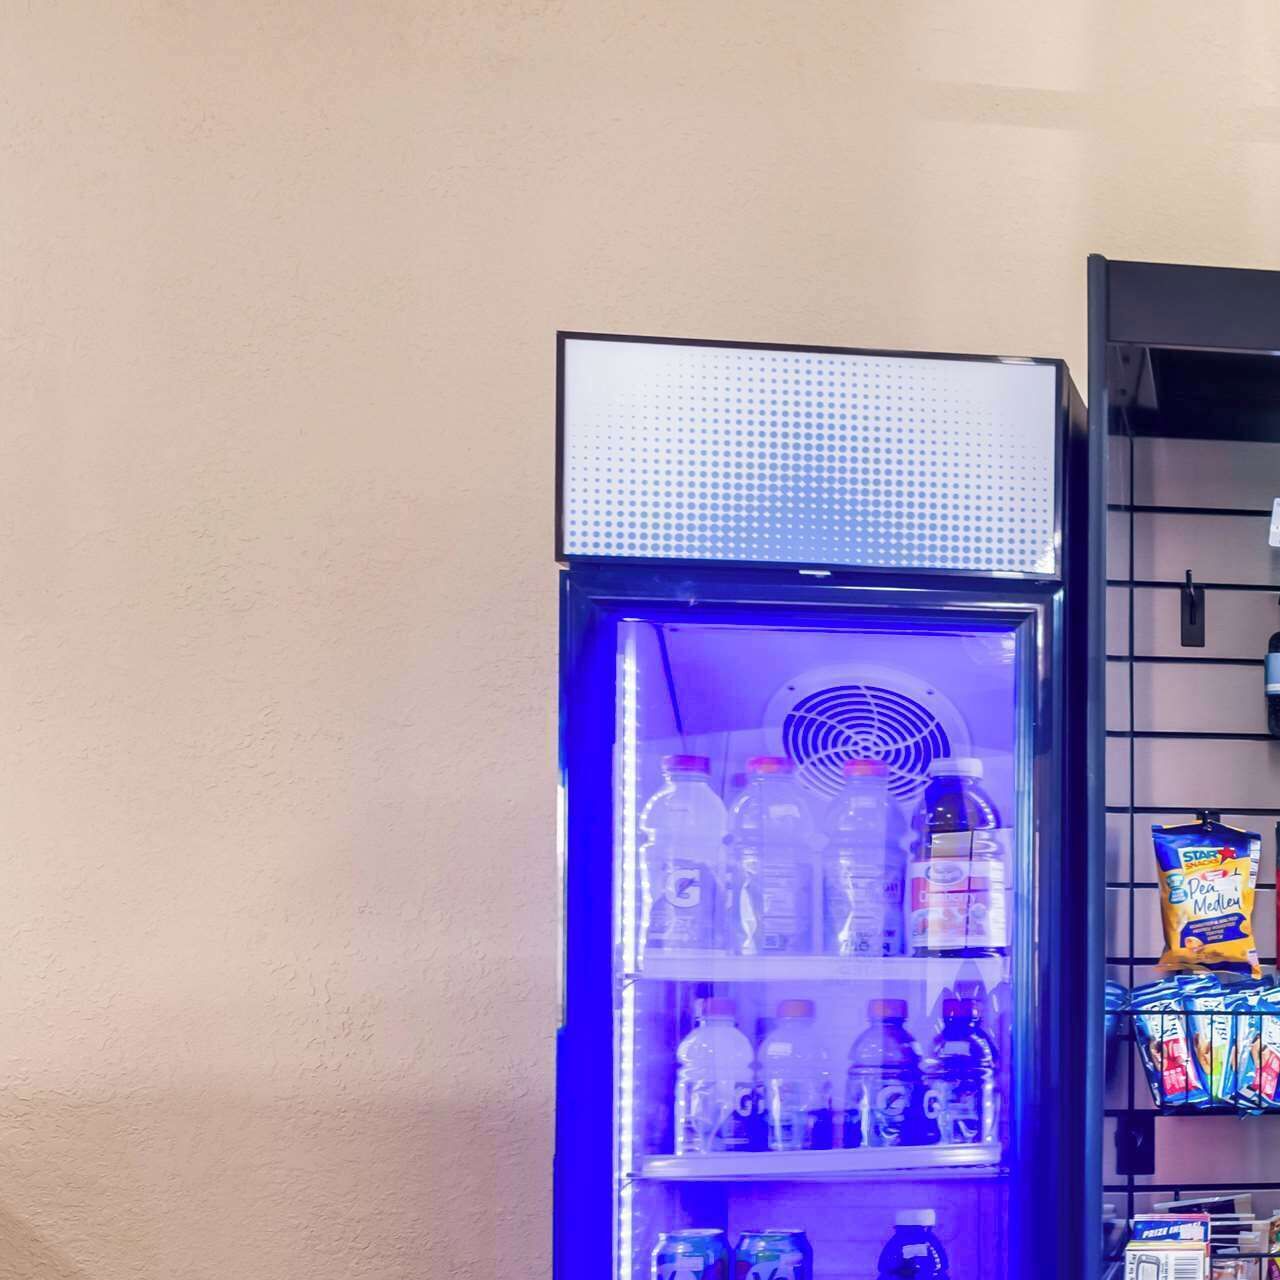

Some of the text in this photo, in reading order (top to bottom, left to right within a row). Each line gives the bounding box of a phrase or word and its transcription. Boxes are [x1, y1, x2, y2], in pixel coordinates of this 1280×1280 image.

[1183, 850, 1218, 863] STAR
[1187, 877, 1218, 899] Pea
[1193, 895, 1241, 915] Medley
